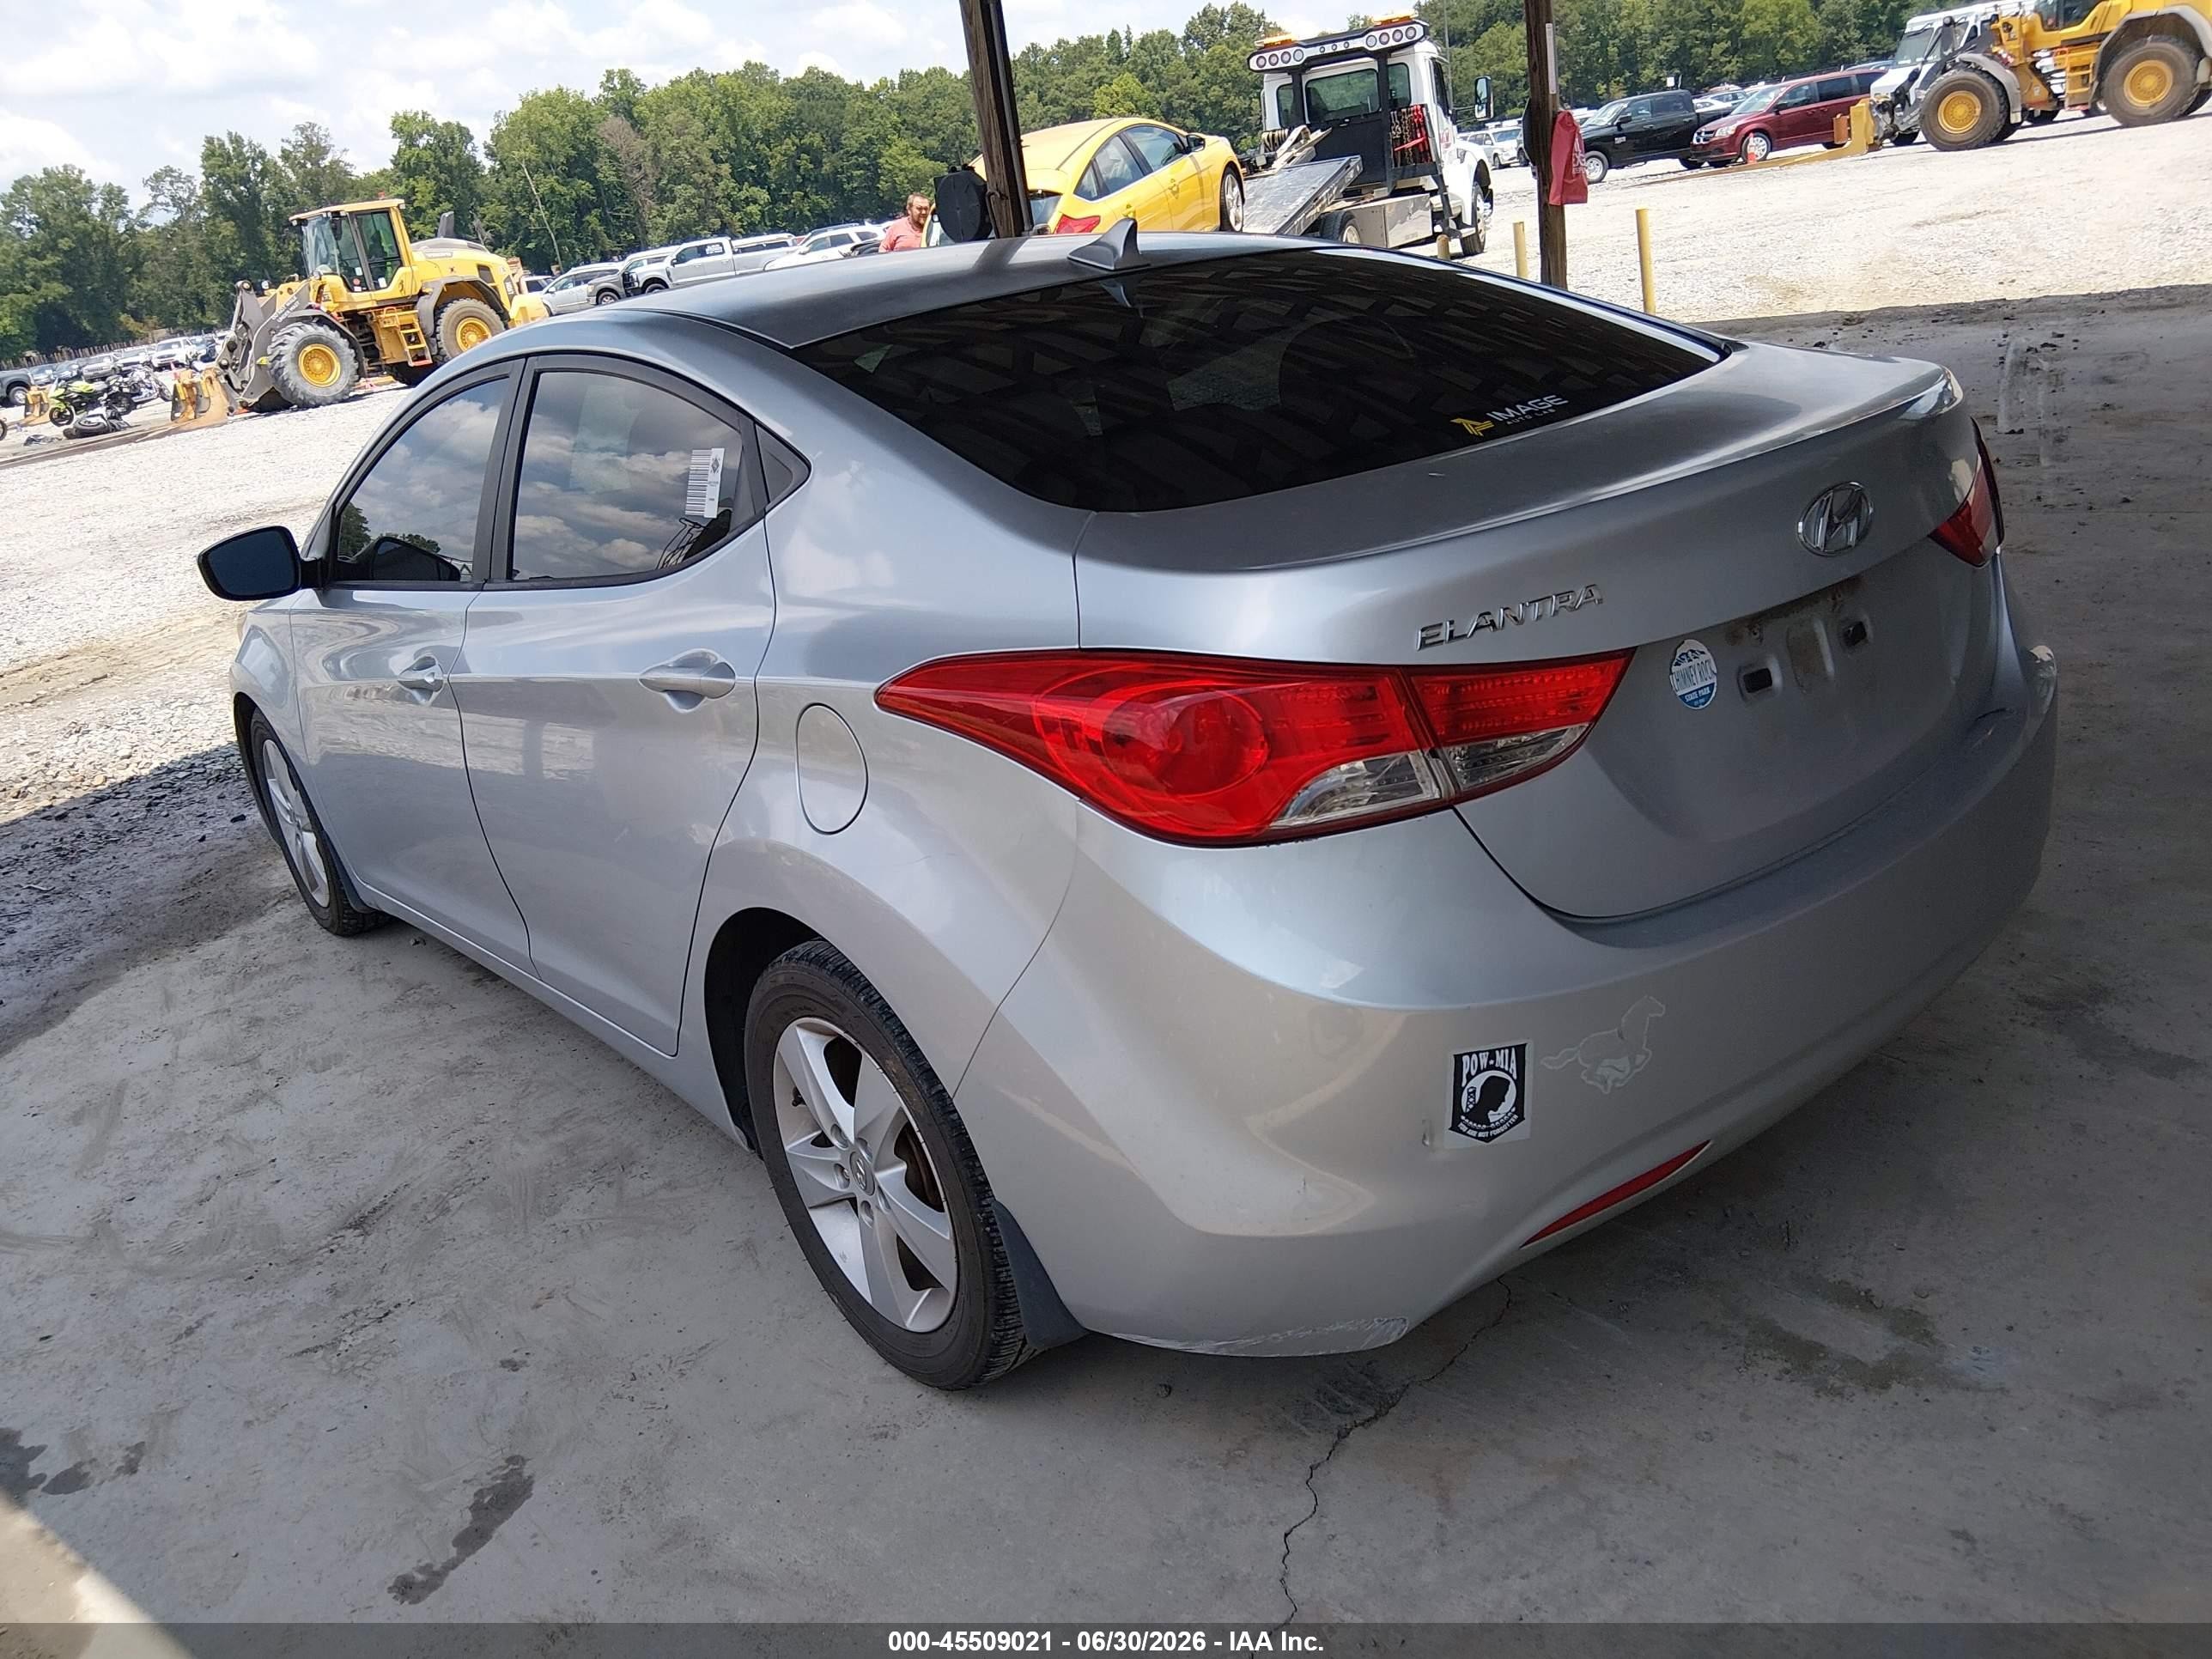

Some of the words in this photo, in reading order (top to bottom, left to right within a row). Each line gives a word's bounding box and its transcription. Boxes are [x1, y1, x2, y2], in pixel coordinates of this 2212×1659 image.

[1486, 394, 1569, 422] IMAGE
[1507, 415, 1533, 425] AUTO
[1417, 584, 1603, 651] ELANTRA
[1489, 1114, 1519, 1137] FORGOTTEN
